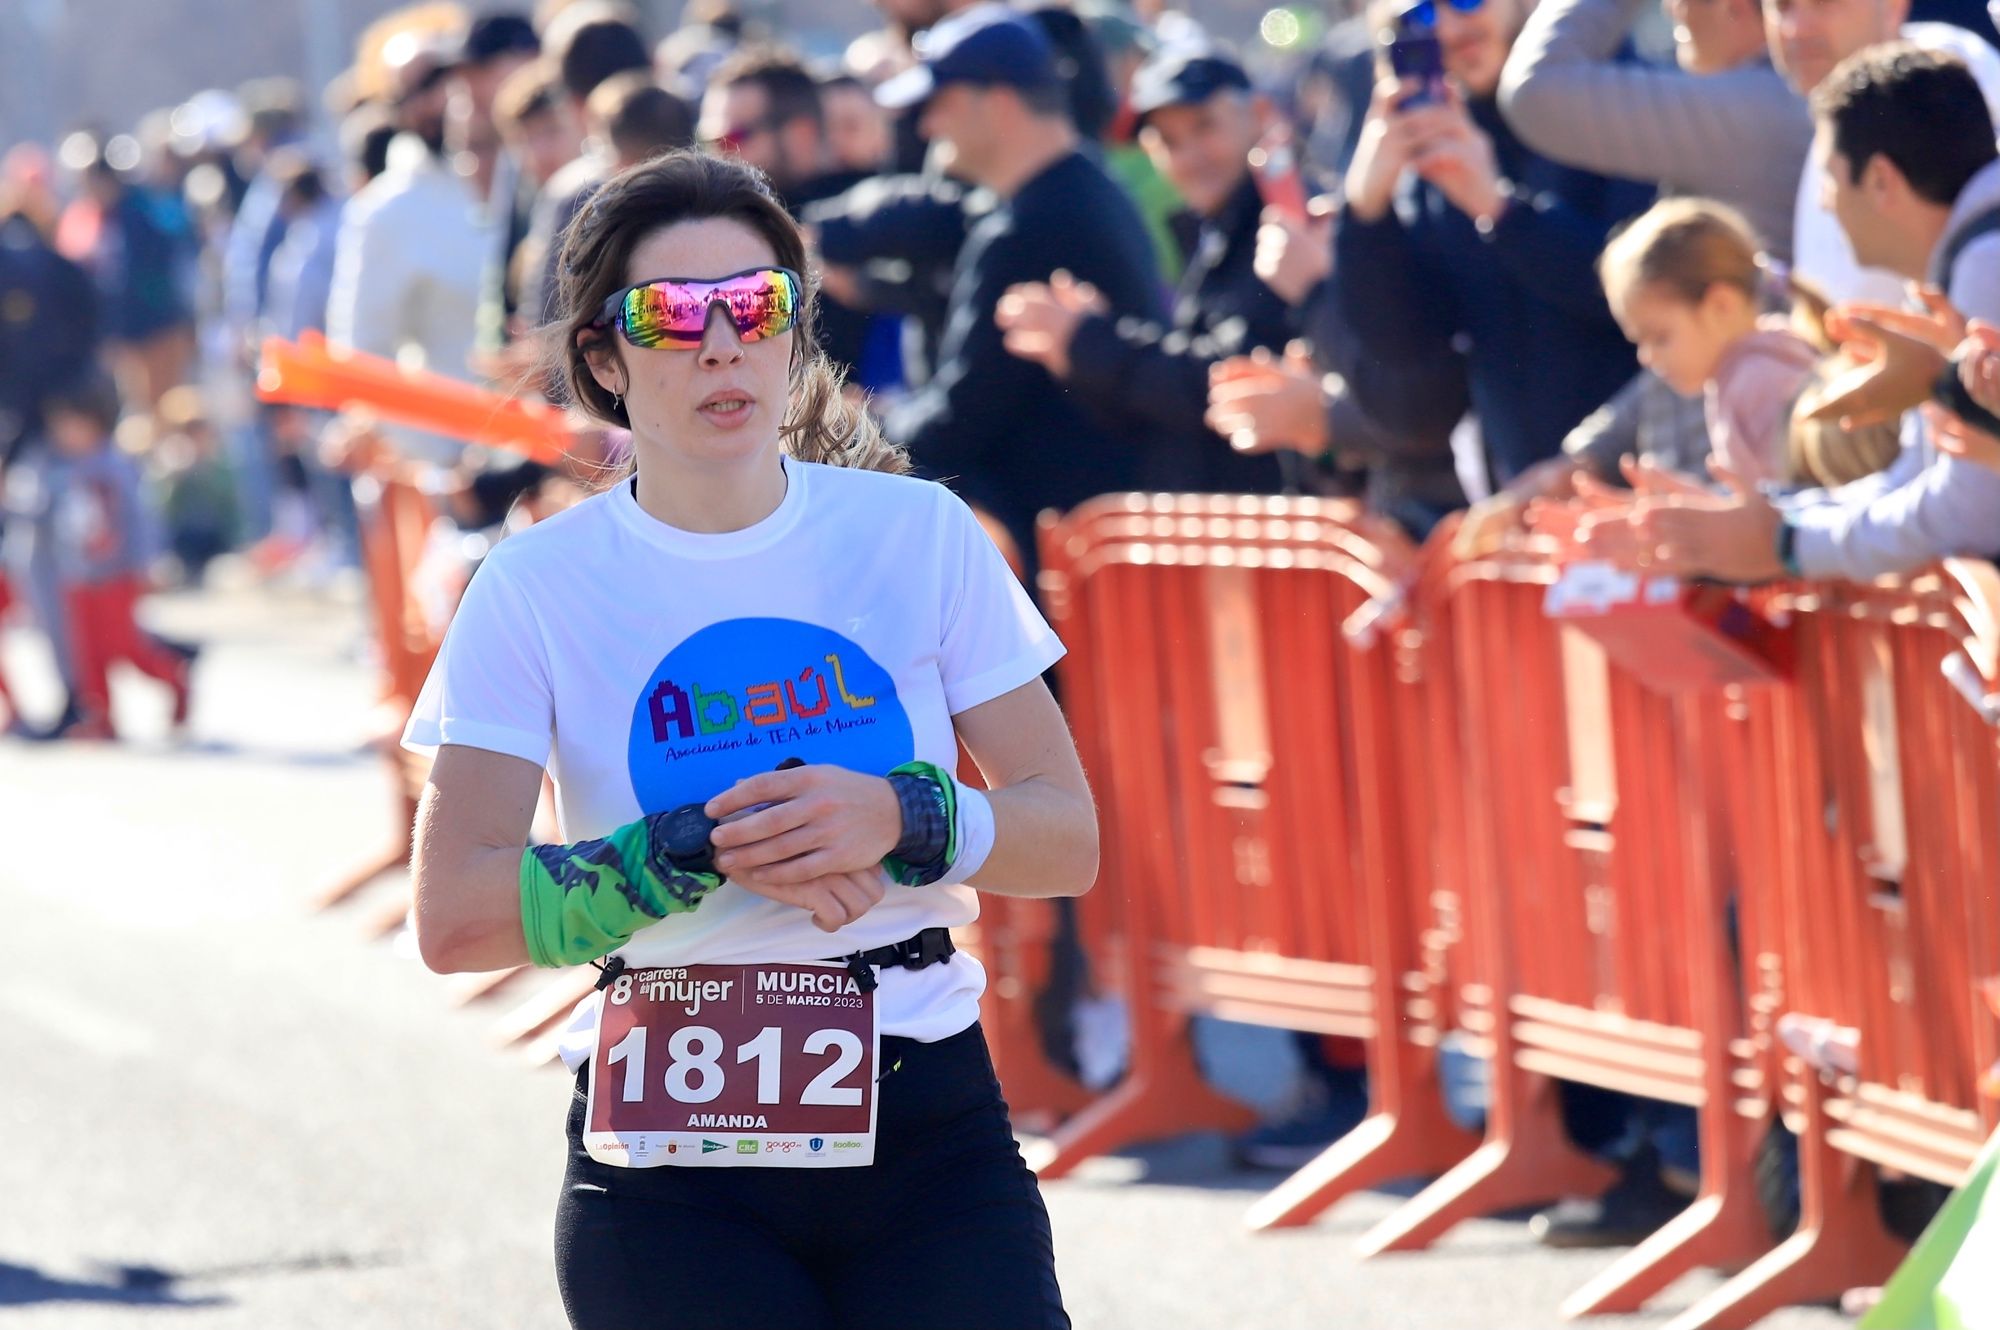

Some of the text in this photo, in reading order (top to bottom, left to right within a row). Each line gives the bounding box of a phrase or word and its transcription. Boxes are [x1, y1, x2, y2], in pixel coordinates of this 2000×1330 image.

[648, 653, 876, 743] Abaúl
[665, 716, 877, 763] Asociación de TEA de Murcia
[639, 968, 688, 982] carrera
[757, 971, 861, 996] MURCIA
[649, 980, 733, 1016] mujer
[756, 994, 863, 1008] 5 DE MARZO 2023
[608, 1026, 863, 1106] 1812
[687, 1114, 768, 1129] AMANDA
